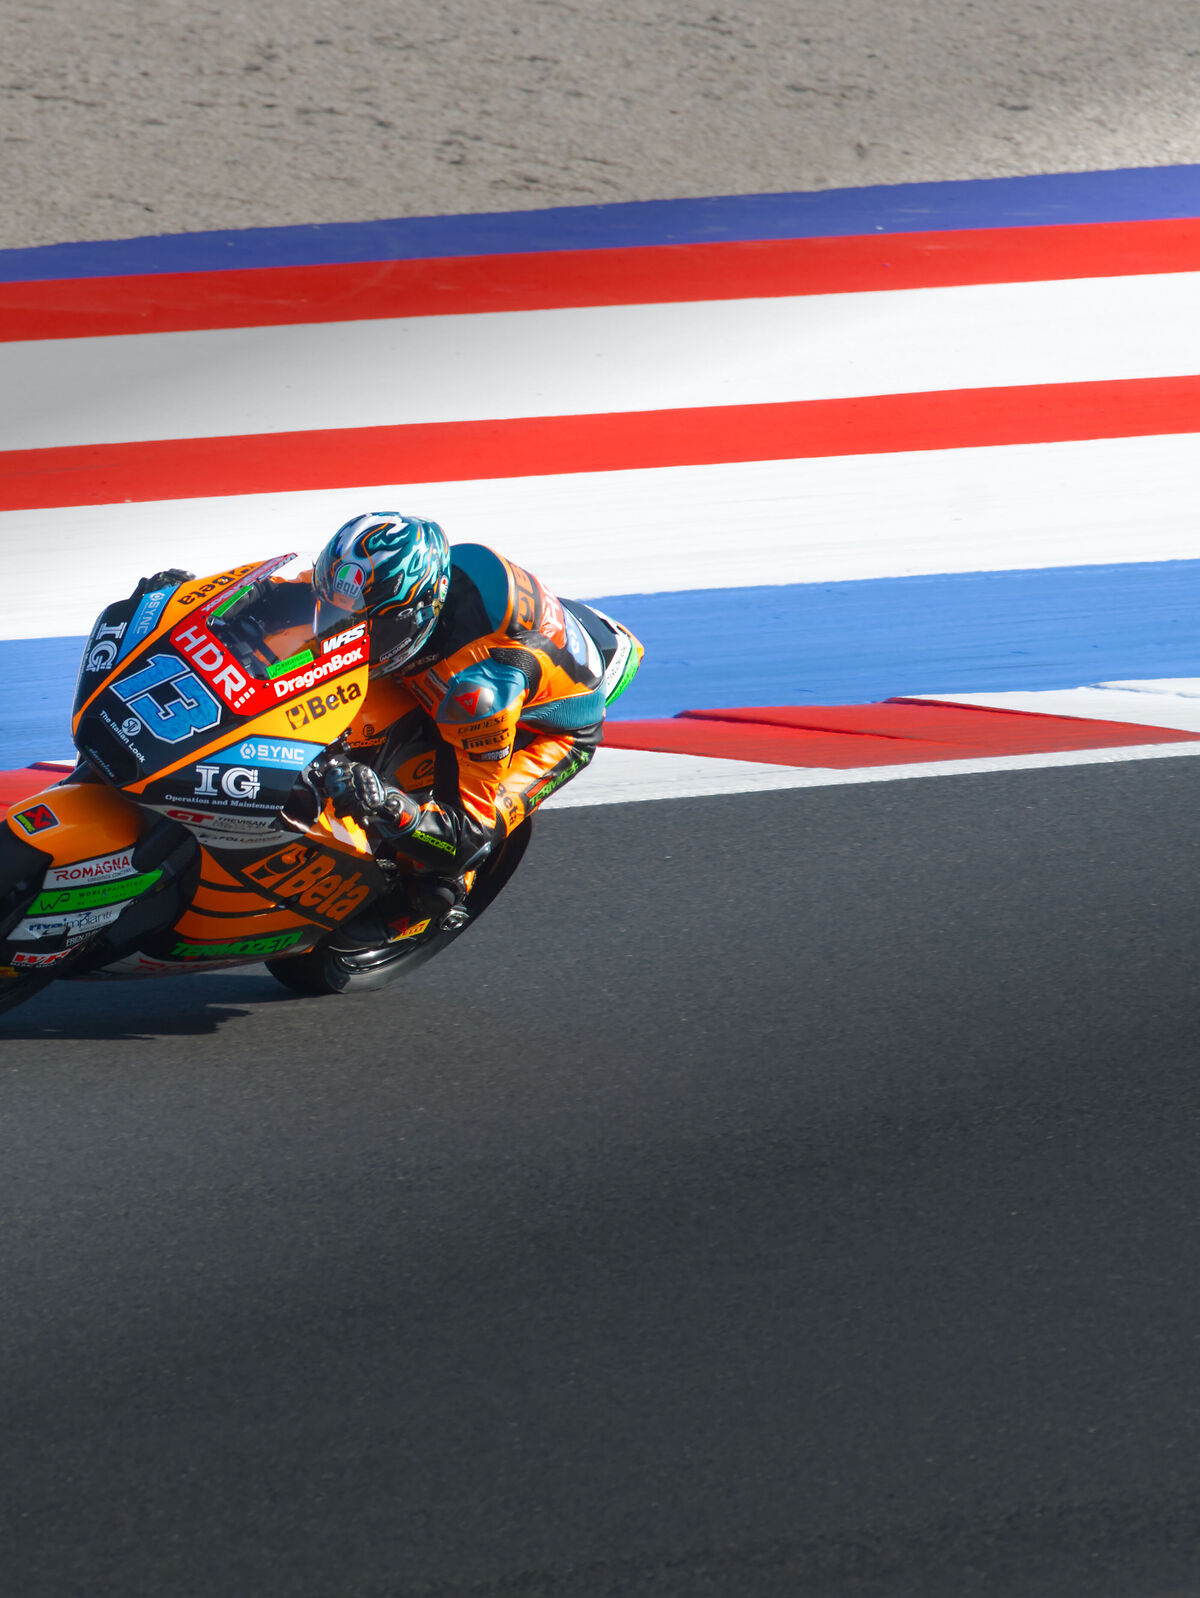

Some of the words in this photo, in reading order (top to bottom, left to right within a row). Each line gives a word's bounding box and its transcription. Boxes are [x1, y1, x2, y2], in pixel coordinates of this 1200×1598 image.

[177, 575, 235, 605] Beta
[136, 600, 159, 634] SYNC
[86, 622, 127, 673] IG
[323, 623, 366, 655] WRS
[175, 625, 247, 701] HDR
[273, 647, 364, 698] DragonBox
[109, 653, 222, 744] 13
[306, 682, 362, 721] Beta
[99, 709, 112, 723] The
[110, 721, 130, 745] Italian
[128, 742, 147, 764] Lock
[257, 745, 305, 761] SYNC
[194, 764, 261, 800] IG
[165, 793, 210, 805] Operation
[211, 799, 229, 807] and
[230, 799, 285, 811] Maintenance
[53, 855, 131, 882] ROMAGNA
[272, 853, 371, 922] Beta
